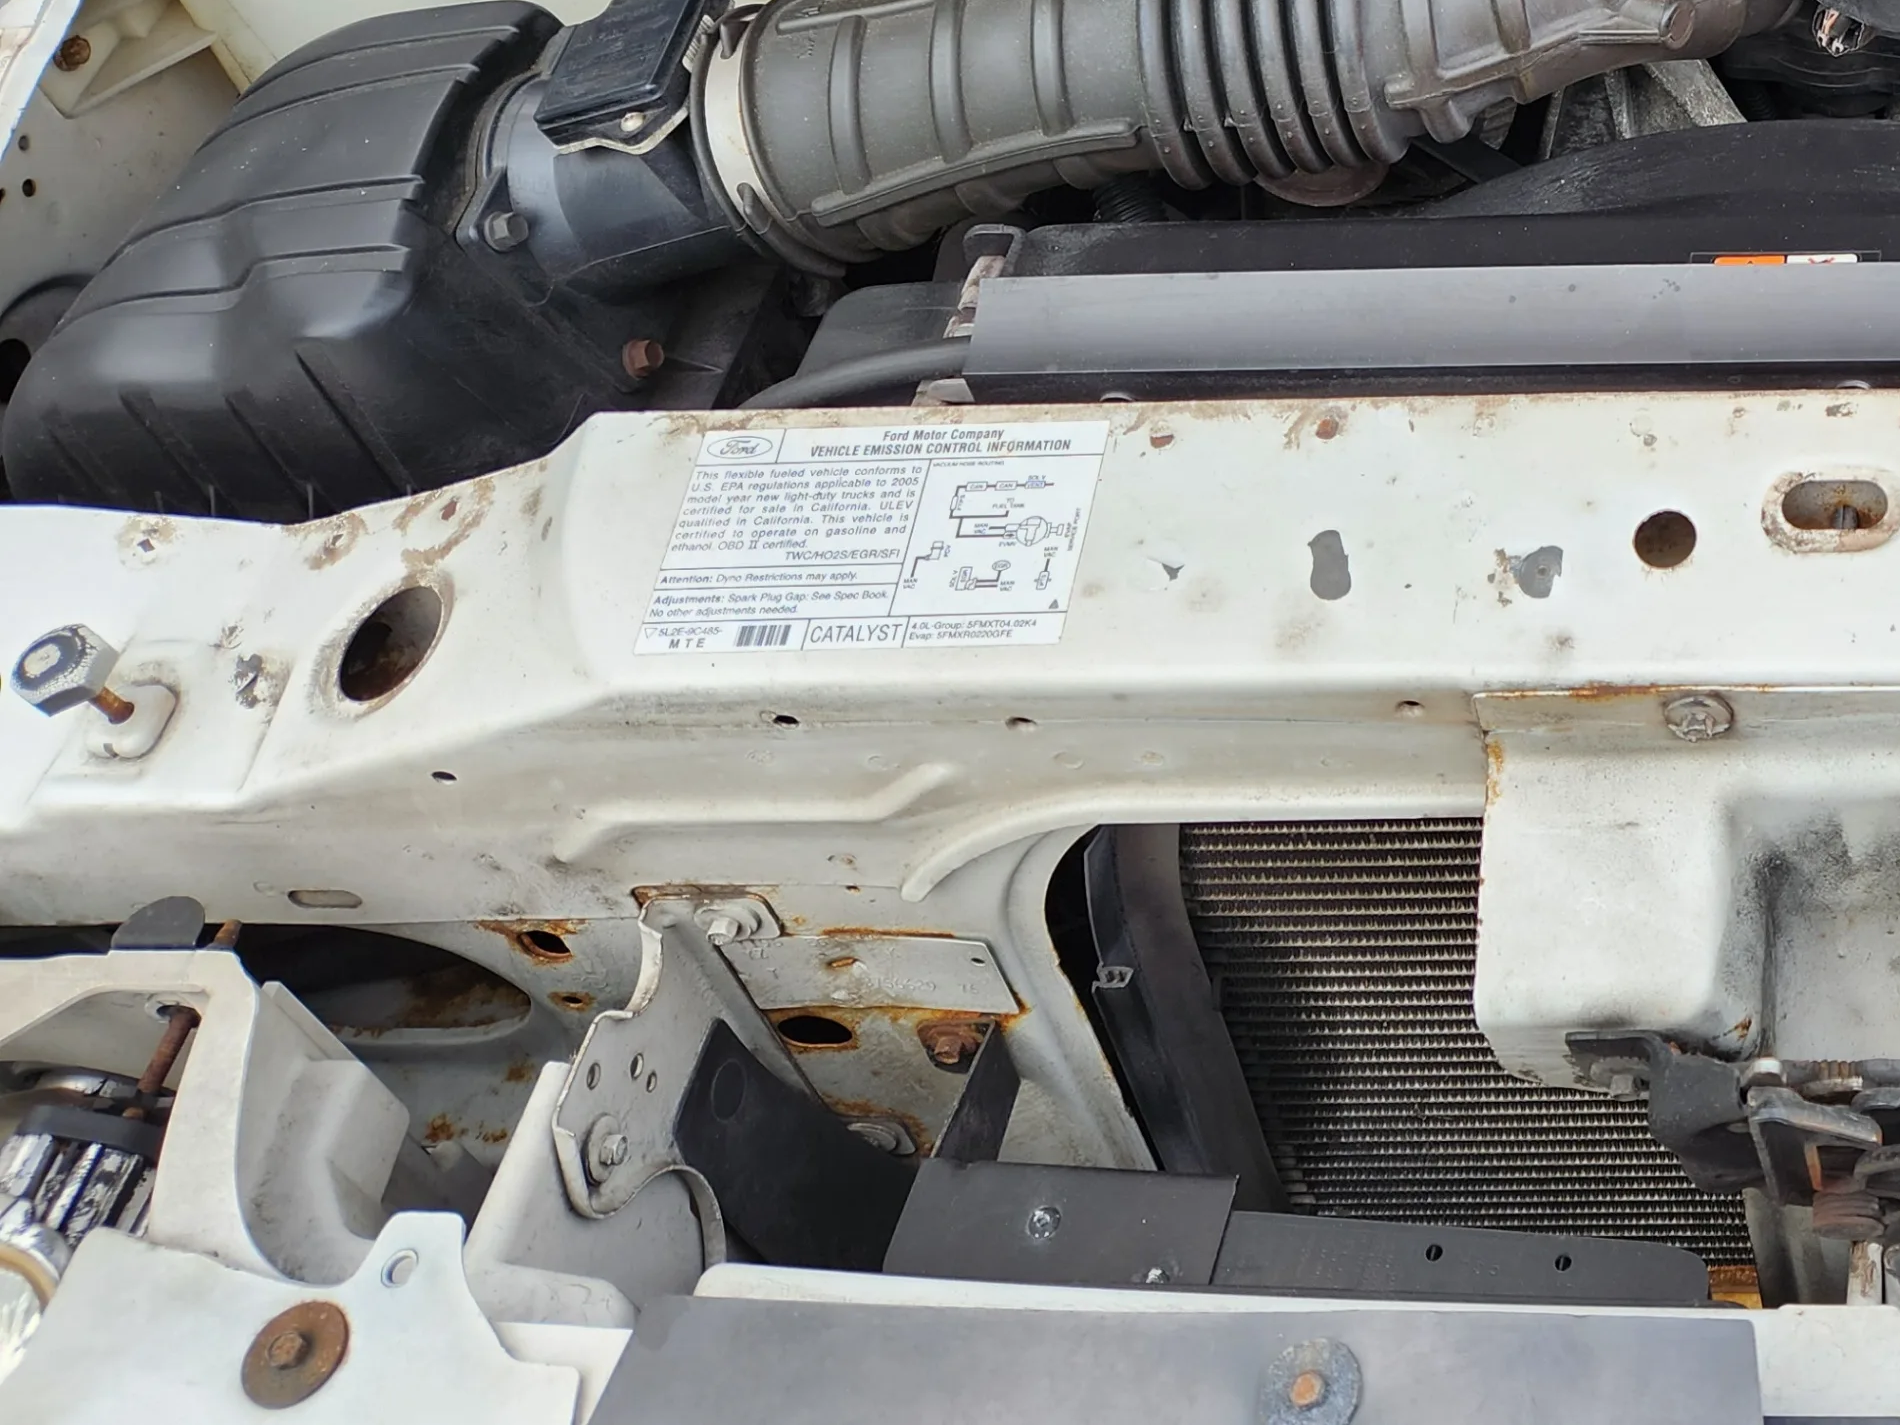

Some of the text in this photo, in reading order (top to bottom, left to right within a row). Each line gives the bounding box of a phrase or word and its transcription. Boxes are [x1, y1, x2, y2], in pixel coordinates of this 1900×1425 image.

[883, 428, 1004, 441] Ford Motor Company
[719, 439, 761, 456] Ford
[810, 440, 1071, 457] VEHICLE EMISSION CONTROL INFORMATION
[695, 465, 921, 480] This flexible fueled vehicle conforms to
[691, 483, 714, 492] U.S.
[721, 482, 743, 491] EPA
[748, 480, 809, 492] regulations
[815, 479, 871, 489] applicable
[891, 477, 919, 486] 2005
[688, 489, 915, 504] model year new light-duty trucks and is
[683, 501, 913, 515] certified for sale in California. ULEV
[785, 549, 900, 560] TWC/HO2S/EGR/SFI
[660, 571, 857, 584] Attention: Dyno Restrictions may apply.
[653, 590, 888, 605] Adjustments: Spark Plug Gap: See Spec Book.
[911, 621, 964, 630] 4.0L-Group:
[810, 624, 902, 643] CATALYST
